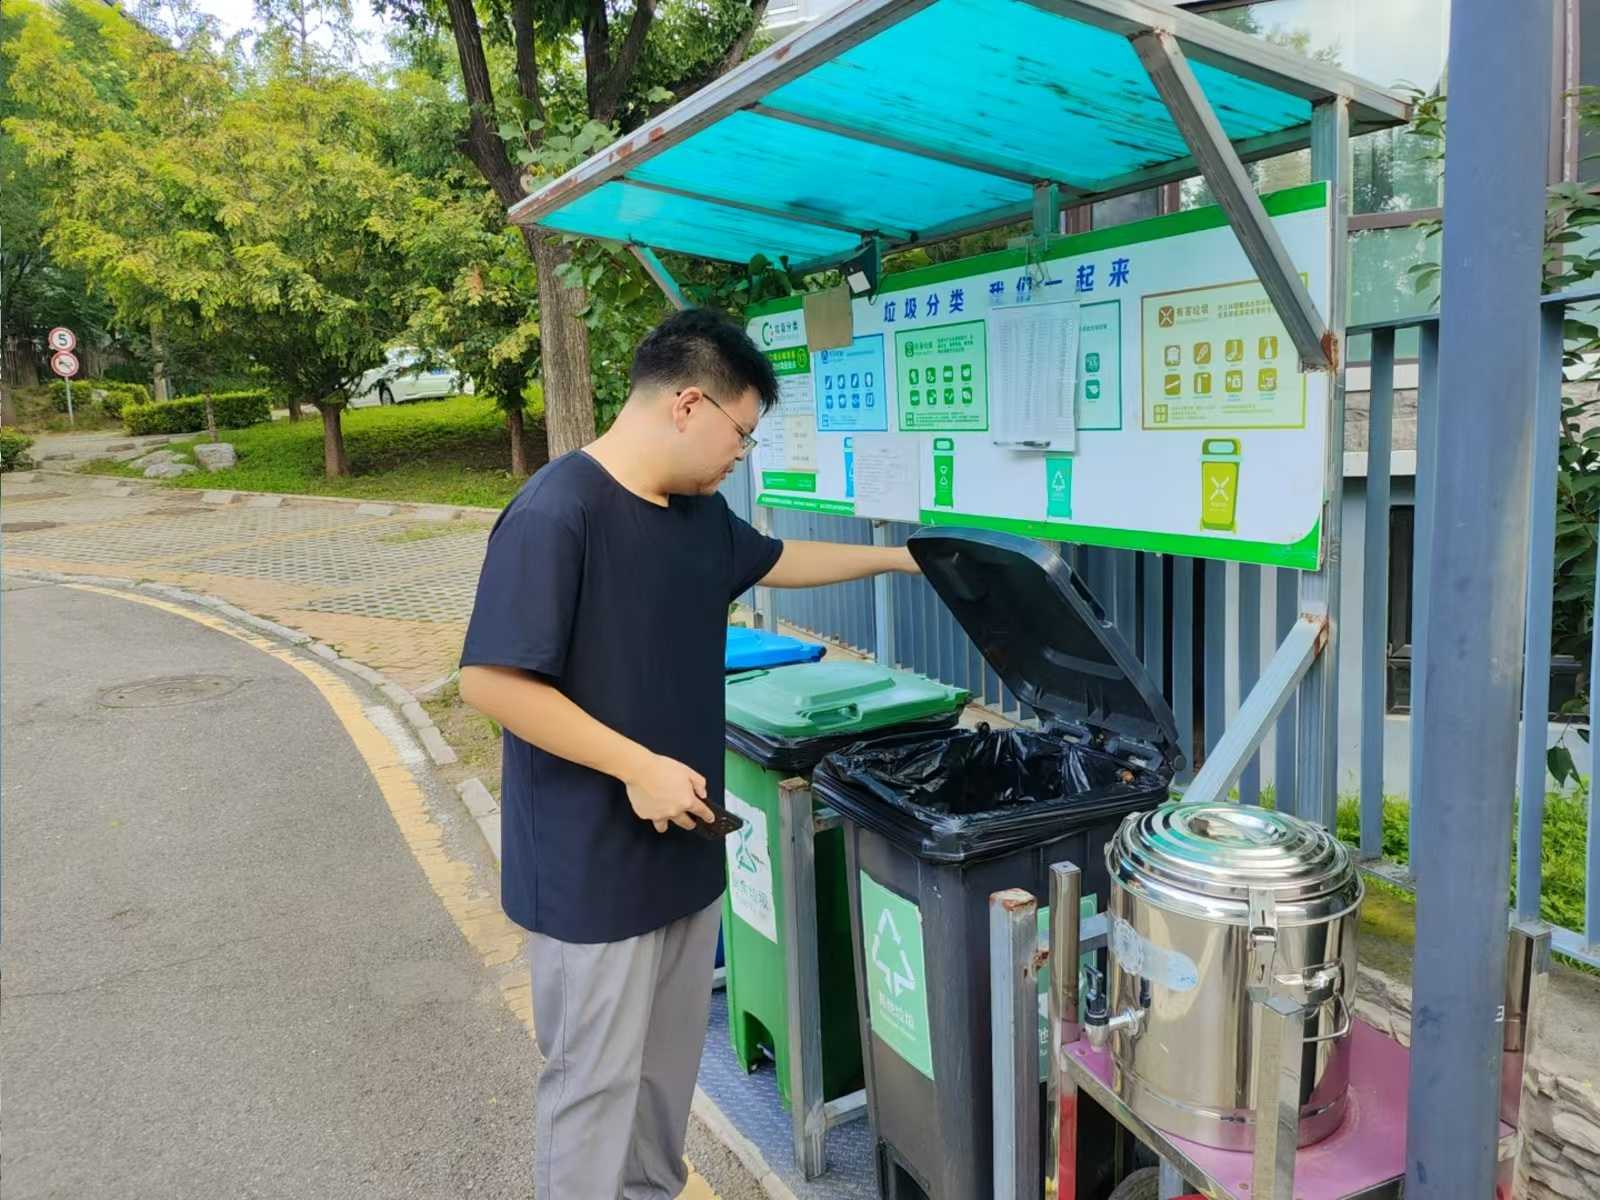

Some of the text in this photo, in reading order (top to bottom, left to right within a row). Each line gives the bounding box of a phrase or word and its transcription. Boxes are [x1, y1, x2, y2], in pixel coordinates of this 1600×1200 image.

[883, 289, 965, 323] 垃圾分类
[58, 334, 68, 346] 5
